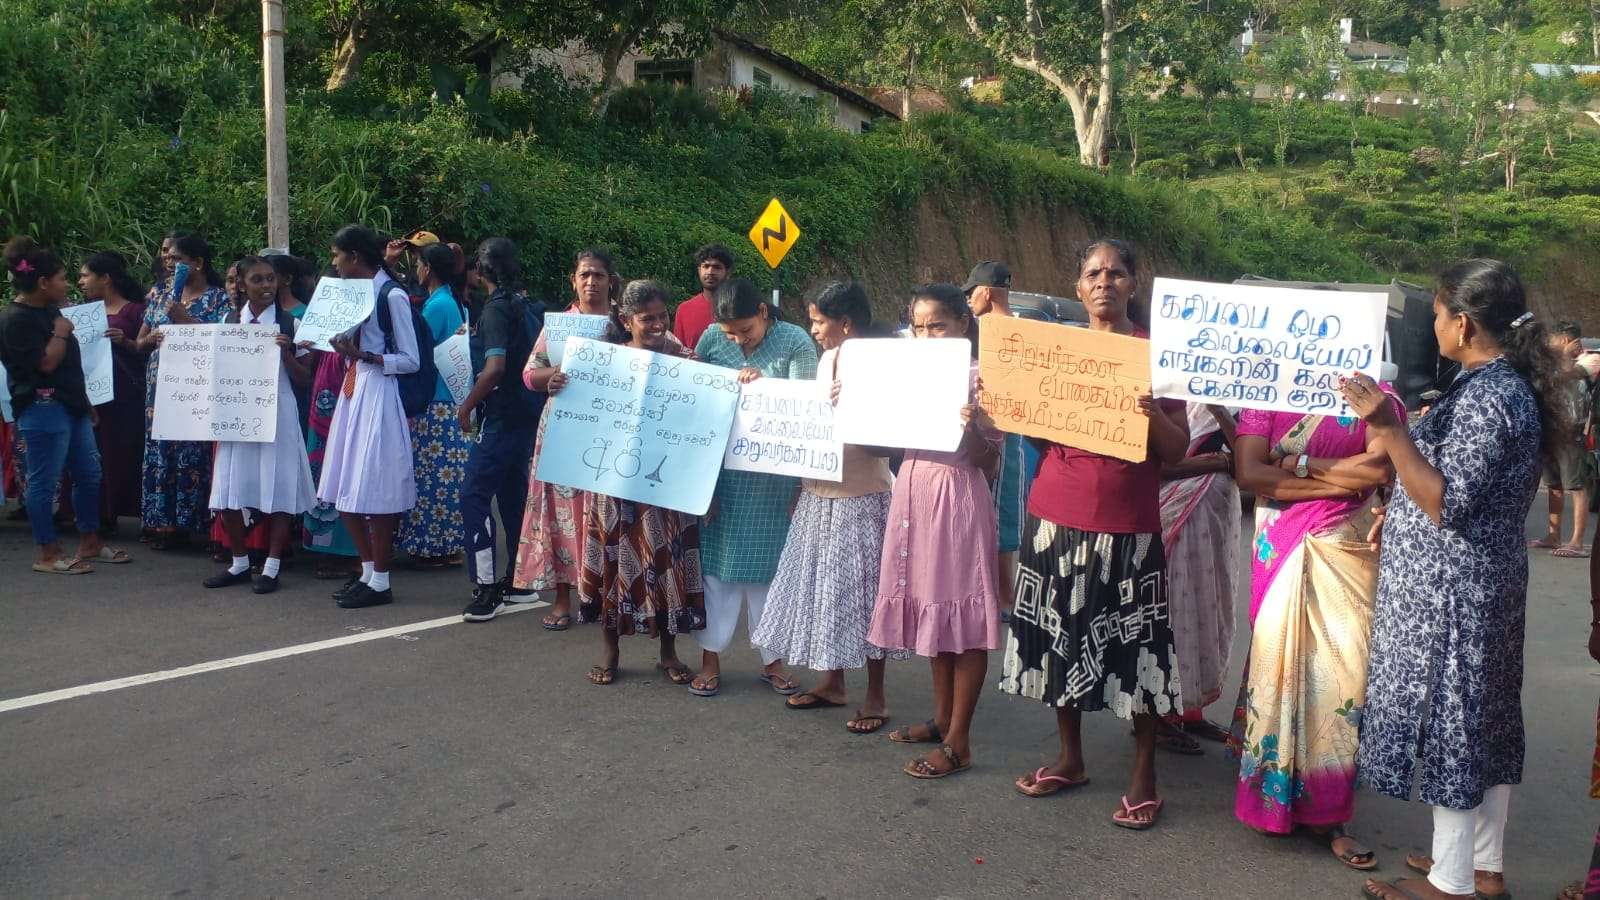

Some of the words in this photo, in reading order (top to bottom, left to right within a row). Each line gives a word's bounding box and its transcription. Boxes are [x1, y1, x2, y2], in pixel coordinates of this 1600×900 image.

[998, 332, 1123, 383] சிறுவர்களை
[1158, 348, 1281, 382] எங்களின்
[1294, 368, 1344, 392] கல்
[1187, 327, 1373, 370] இல்லையேல்
